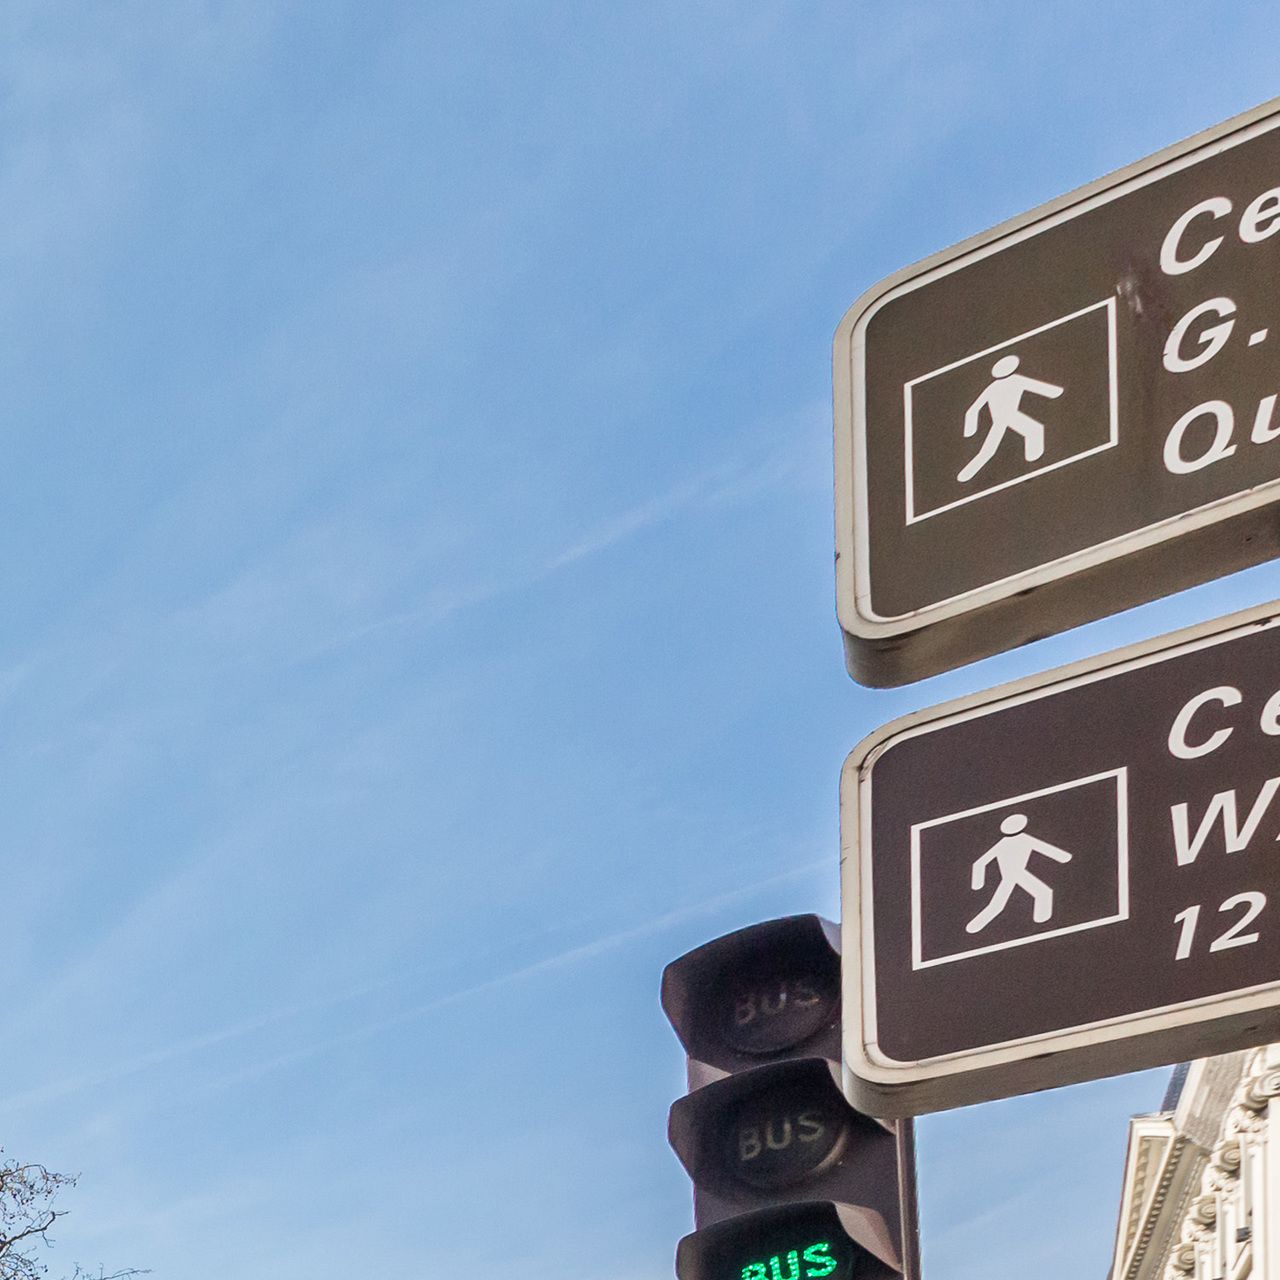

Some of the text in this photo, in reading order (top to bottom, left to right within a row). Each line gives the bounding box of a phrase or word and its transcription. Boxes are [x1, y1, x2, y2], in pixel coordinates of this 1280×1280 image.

[1160, 187, 1280, 276] Ce
[1163, 298, 1269, 374] G.
[1171, 777, 1280, 867] W
[1174, 891, 1266, 961] 12
[741, 1112, 824, 1161] BUS
